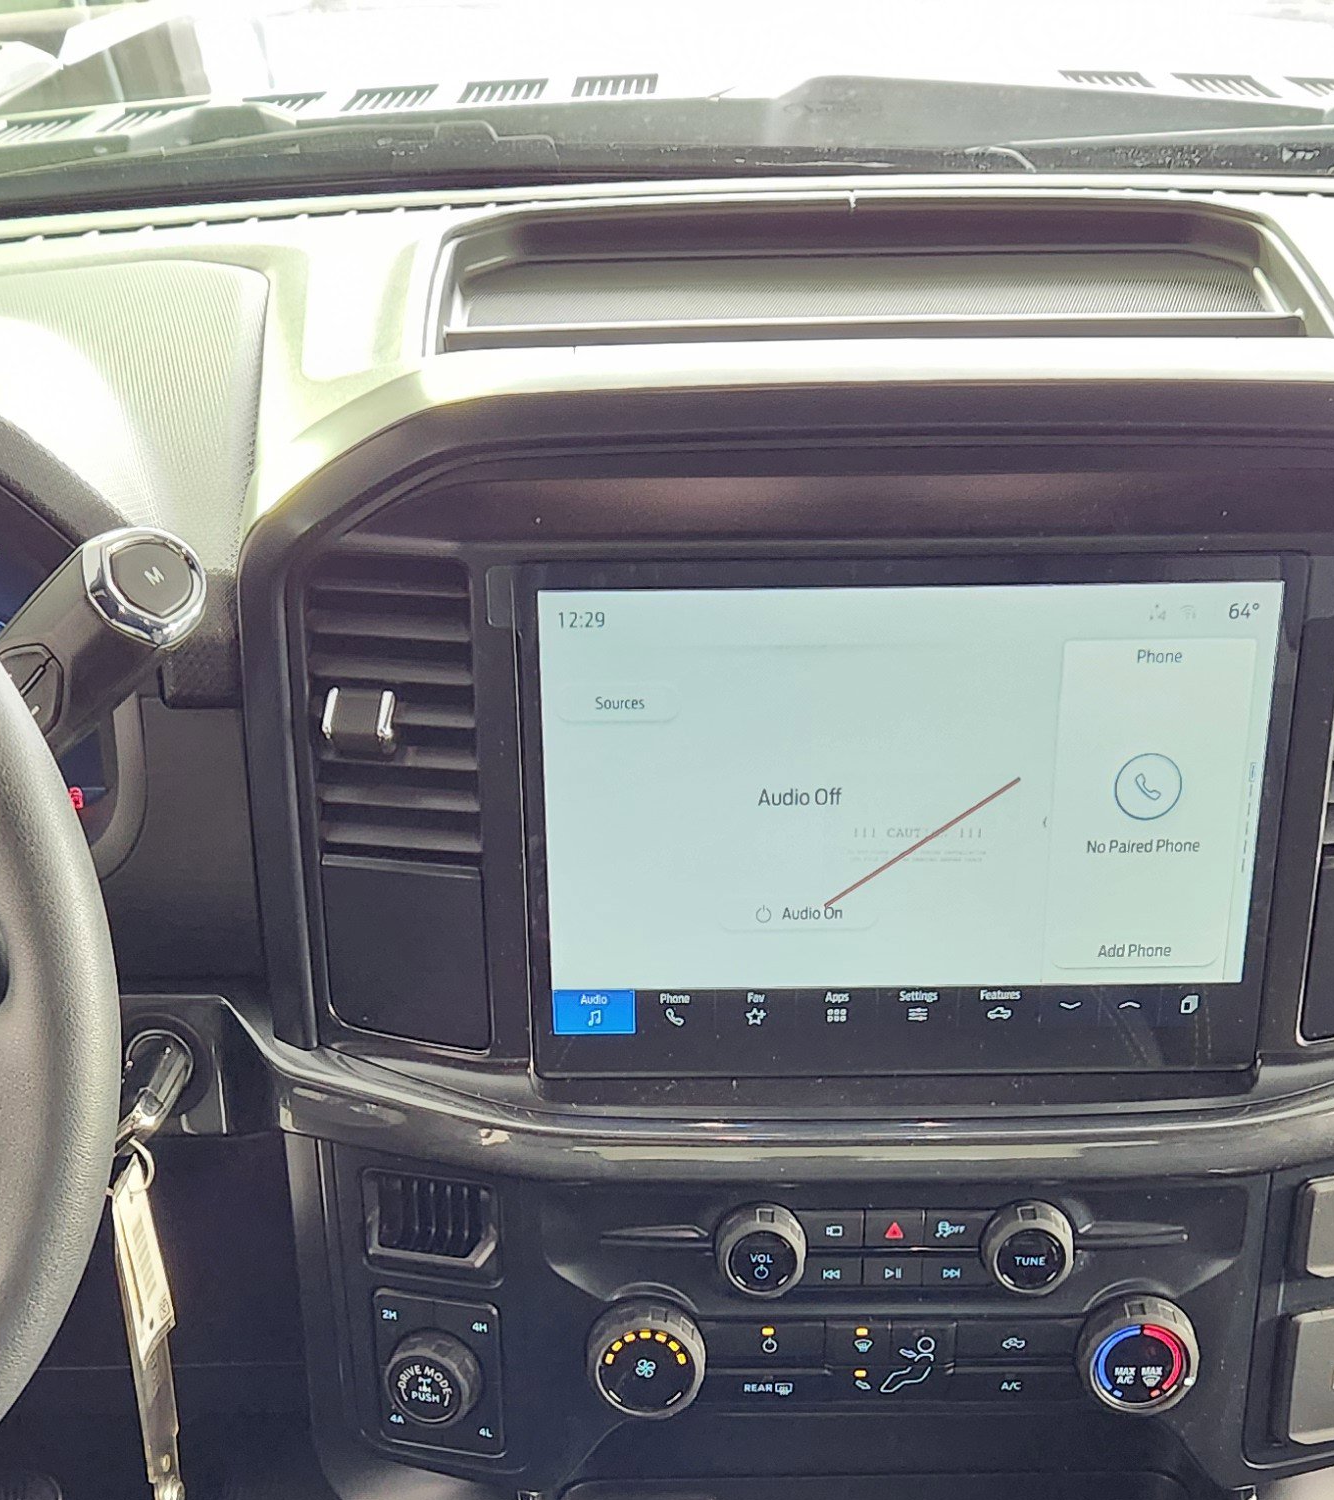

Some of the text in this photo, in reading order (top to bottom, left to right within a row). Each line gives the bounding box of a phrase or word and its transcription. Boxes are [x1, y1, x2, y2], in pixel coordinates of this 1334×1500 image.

[144, 566, 165, 586] M
[1228, 602, 1260, 620] 64°
[558, 611, 605, 628] 12:29
[1137, 648, 1183, 664] Phone
[595, 696, 645, 710] Sources
[757, 786, 843, 807] Audio Off
[1086, 838, 1200, 853] No Paired Phone
[782, 906, 843, 921] Audio On
[1097, 944, 1172, 958] Add Phone
[580, 994, 608, 1006] Audio
[659, 992, 690, 1005] Phone
[746, 992, 766, 1004] Fav
[825, 992, 850, 1006] Apps
[898, 989, 939, 1004] Settings
[979, 988, 1021, 1001] Features
[950, 1225, 965, 1234] OFF
[750, 1253, 773, 1264] VOL
[1014, 1255, 1046, 1267] TUNE
[381, 1309, 397, 1321] 2H
[472, 1322, 488, 1333] 4H
[1114, 1366, 1136, 1377] MAX
[1141, 1366, 1163, 1377] MAX
[397, 1364, 452, 1395] DRIVE MODE
[1116, 1375, 1135, 1386] A/C
[744, 1383, 772, 1393] REAR
[1000, 1381, 1022, 1392] A/C
[411, 1390, 441, 1404] PUSH
[389, 1414, 404, 1424] 4A
[479, 1428, 493, 1438] 4L
